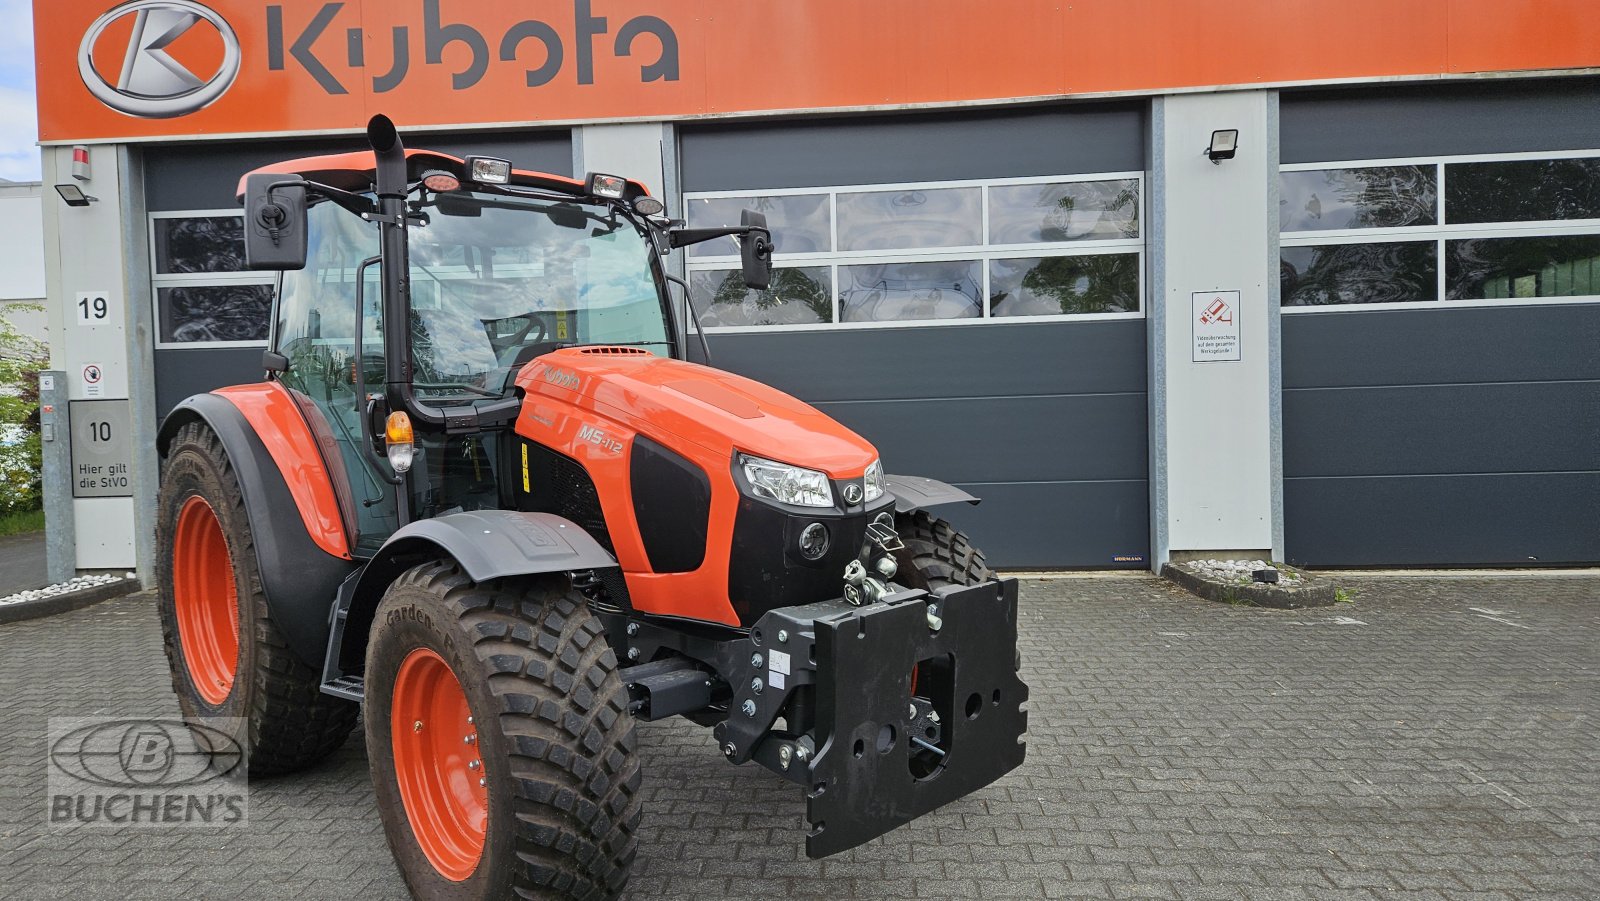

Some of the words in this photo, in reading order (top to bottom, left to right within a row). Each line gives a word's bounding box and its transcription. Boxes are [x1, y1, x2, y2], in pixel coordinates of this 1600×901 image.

[266, 0, 680, 95] Kubota
[79, 297, 107, 320] 19
[544, 365, 581, 391] Kubota
[90, 421, 112, 442] 10
[79, 464, 103, 474] Hier
[108, 463, 127, 476] gilt
[80, 478, 97, 488] die
[100, 477, 128, 488] StVO
